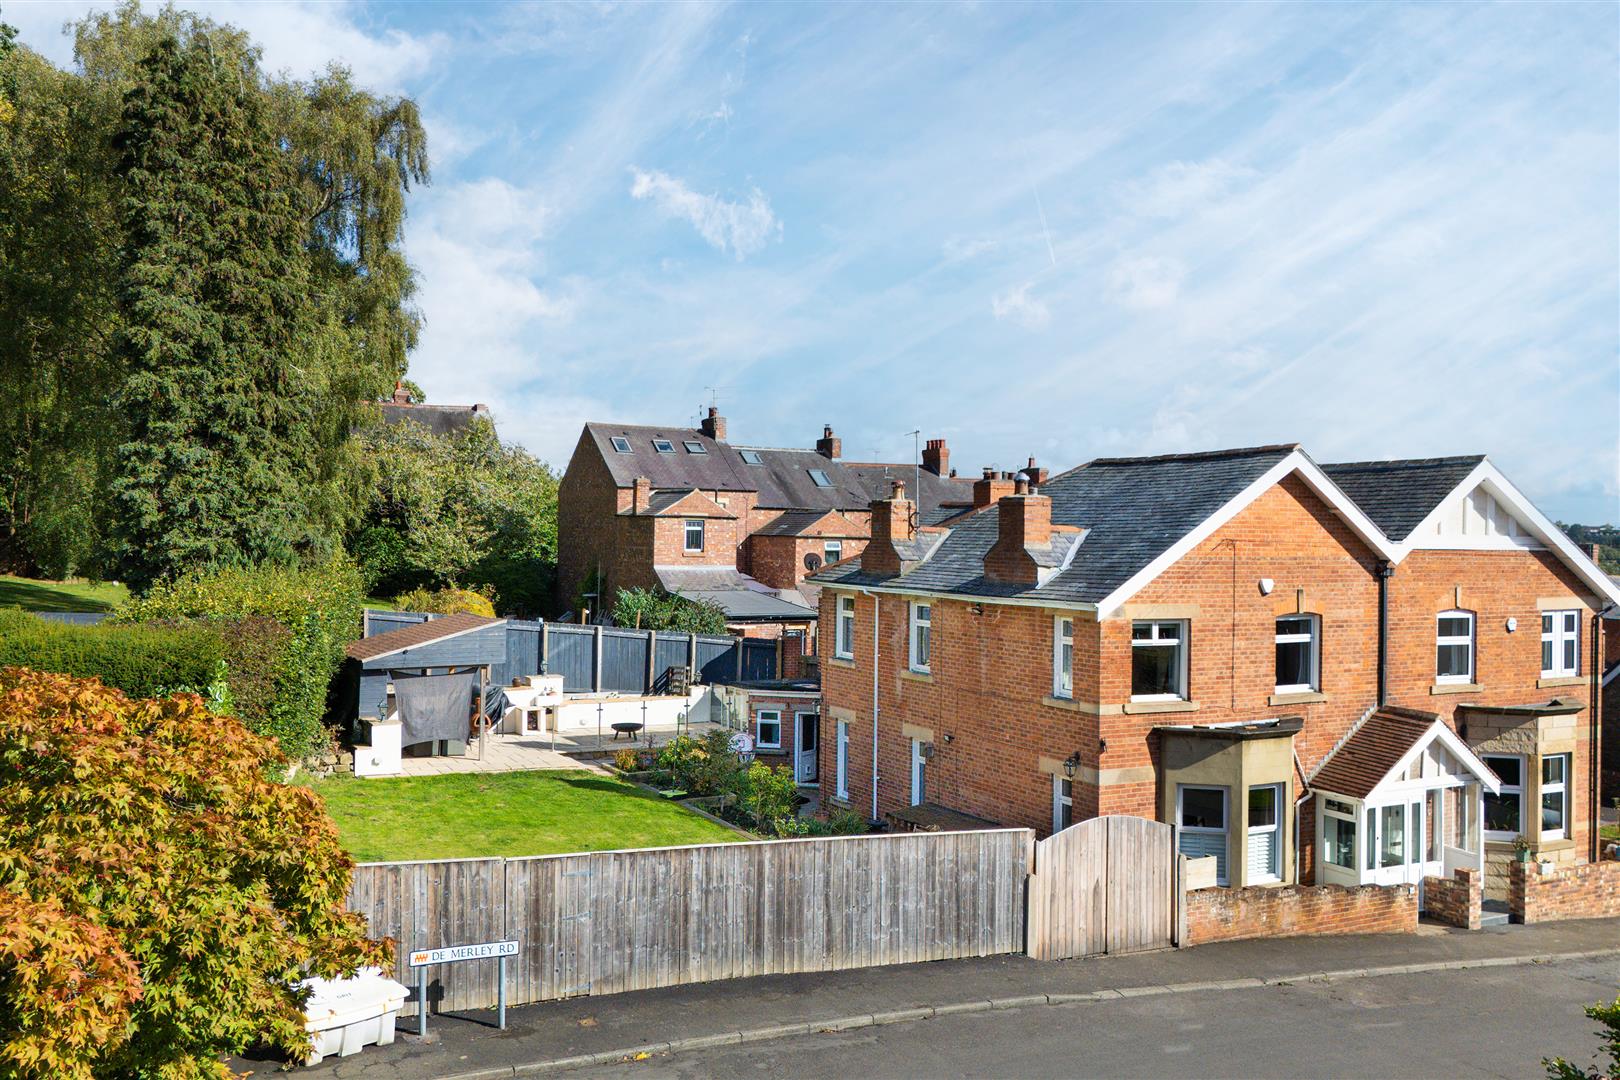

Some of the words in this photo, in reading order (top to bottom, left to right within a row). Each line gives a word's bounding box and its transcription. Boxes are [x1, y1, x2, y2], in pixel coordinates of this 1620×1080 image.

[432, 951, 445, 961] DE
[451, 946, 493, 959] MERLEY
[499, 943, 514, 953] RD
